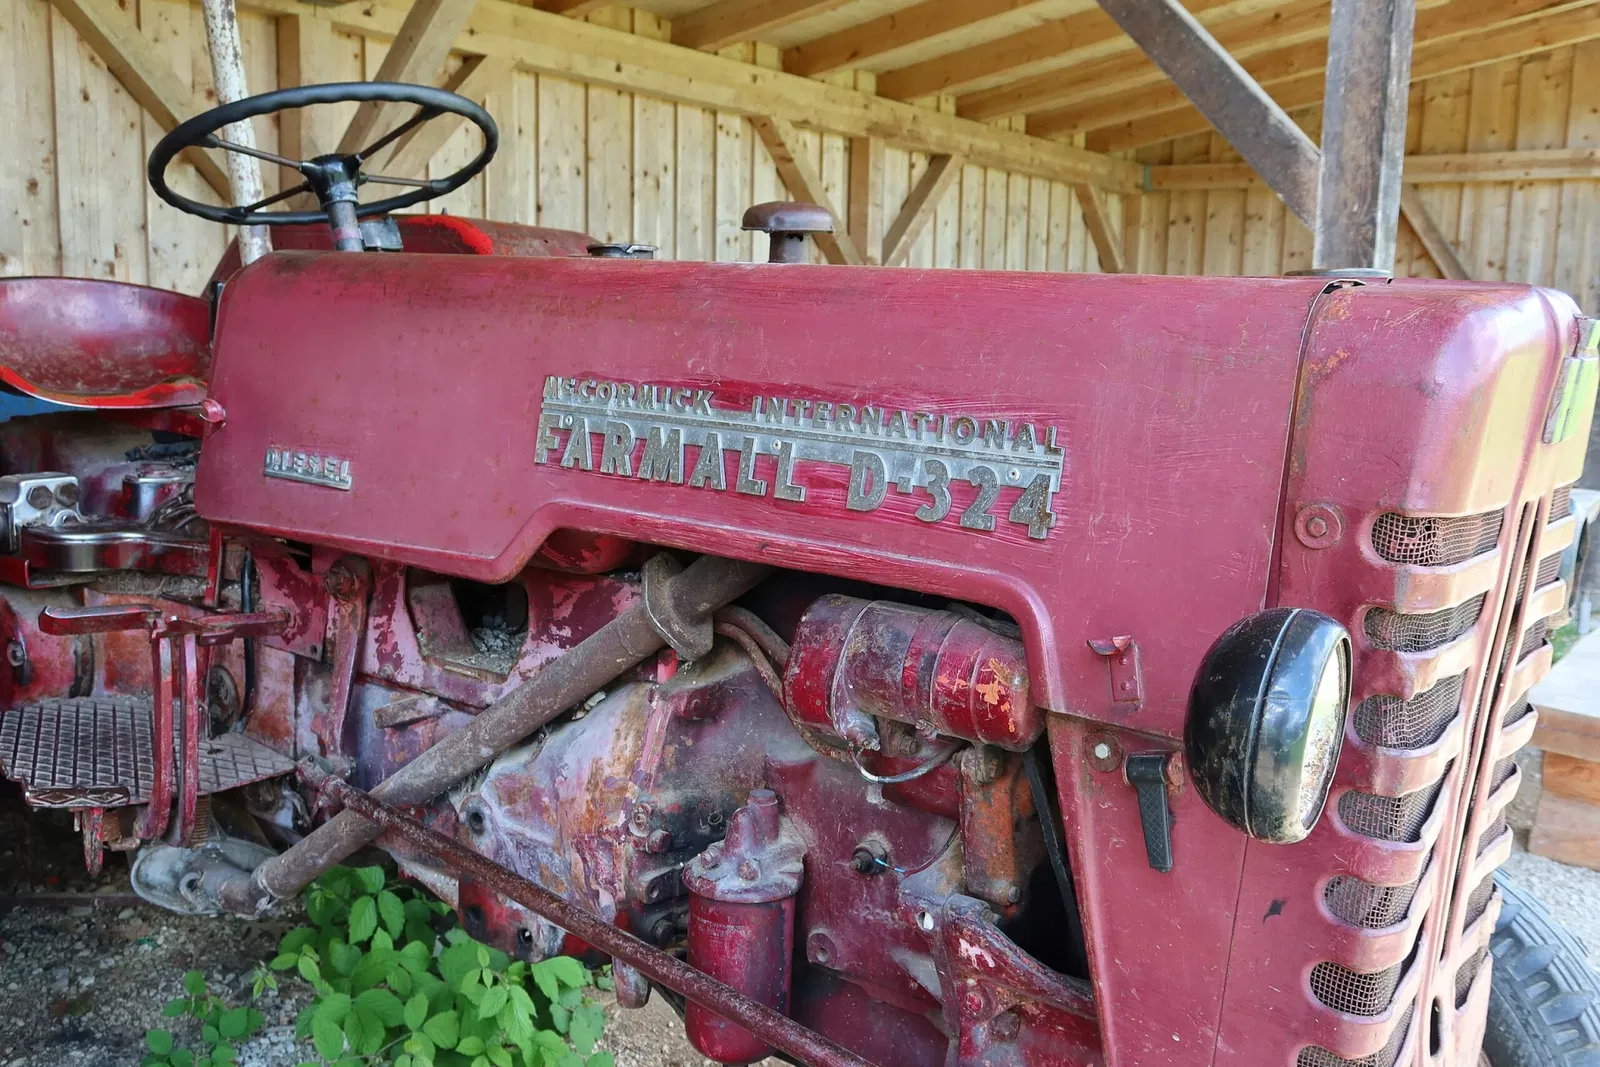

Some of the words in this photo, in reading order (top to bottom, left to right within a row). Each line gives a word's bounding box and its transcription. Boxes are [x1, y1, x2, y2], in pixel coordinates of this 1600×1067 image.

[752, 395, 1065, 454] INTERNATIONAL
[264, 447, 352, 482] DIESEL
[534, 413, 806, 502] FARMALL
[846, 450, 1057, 540] D-324
